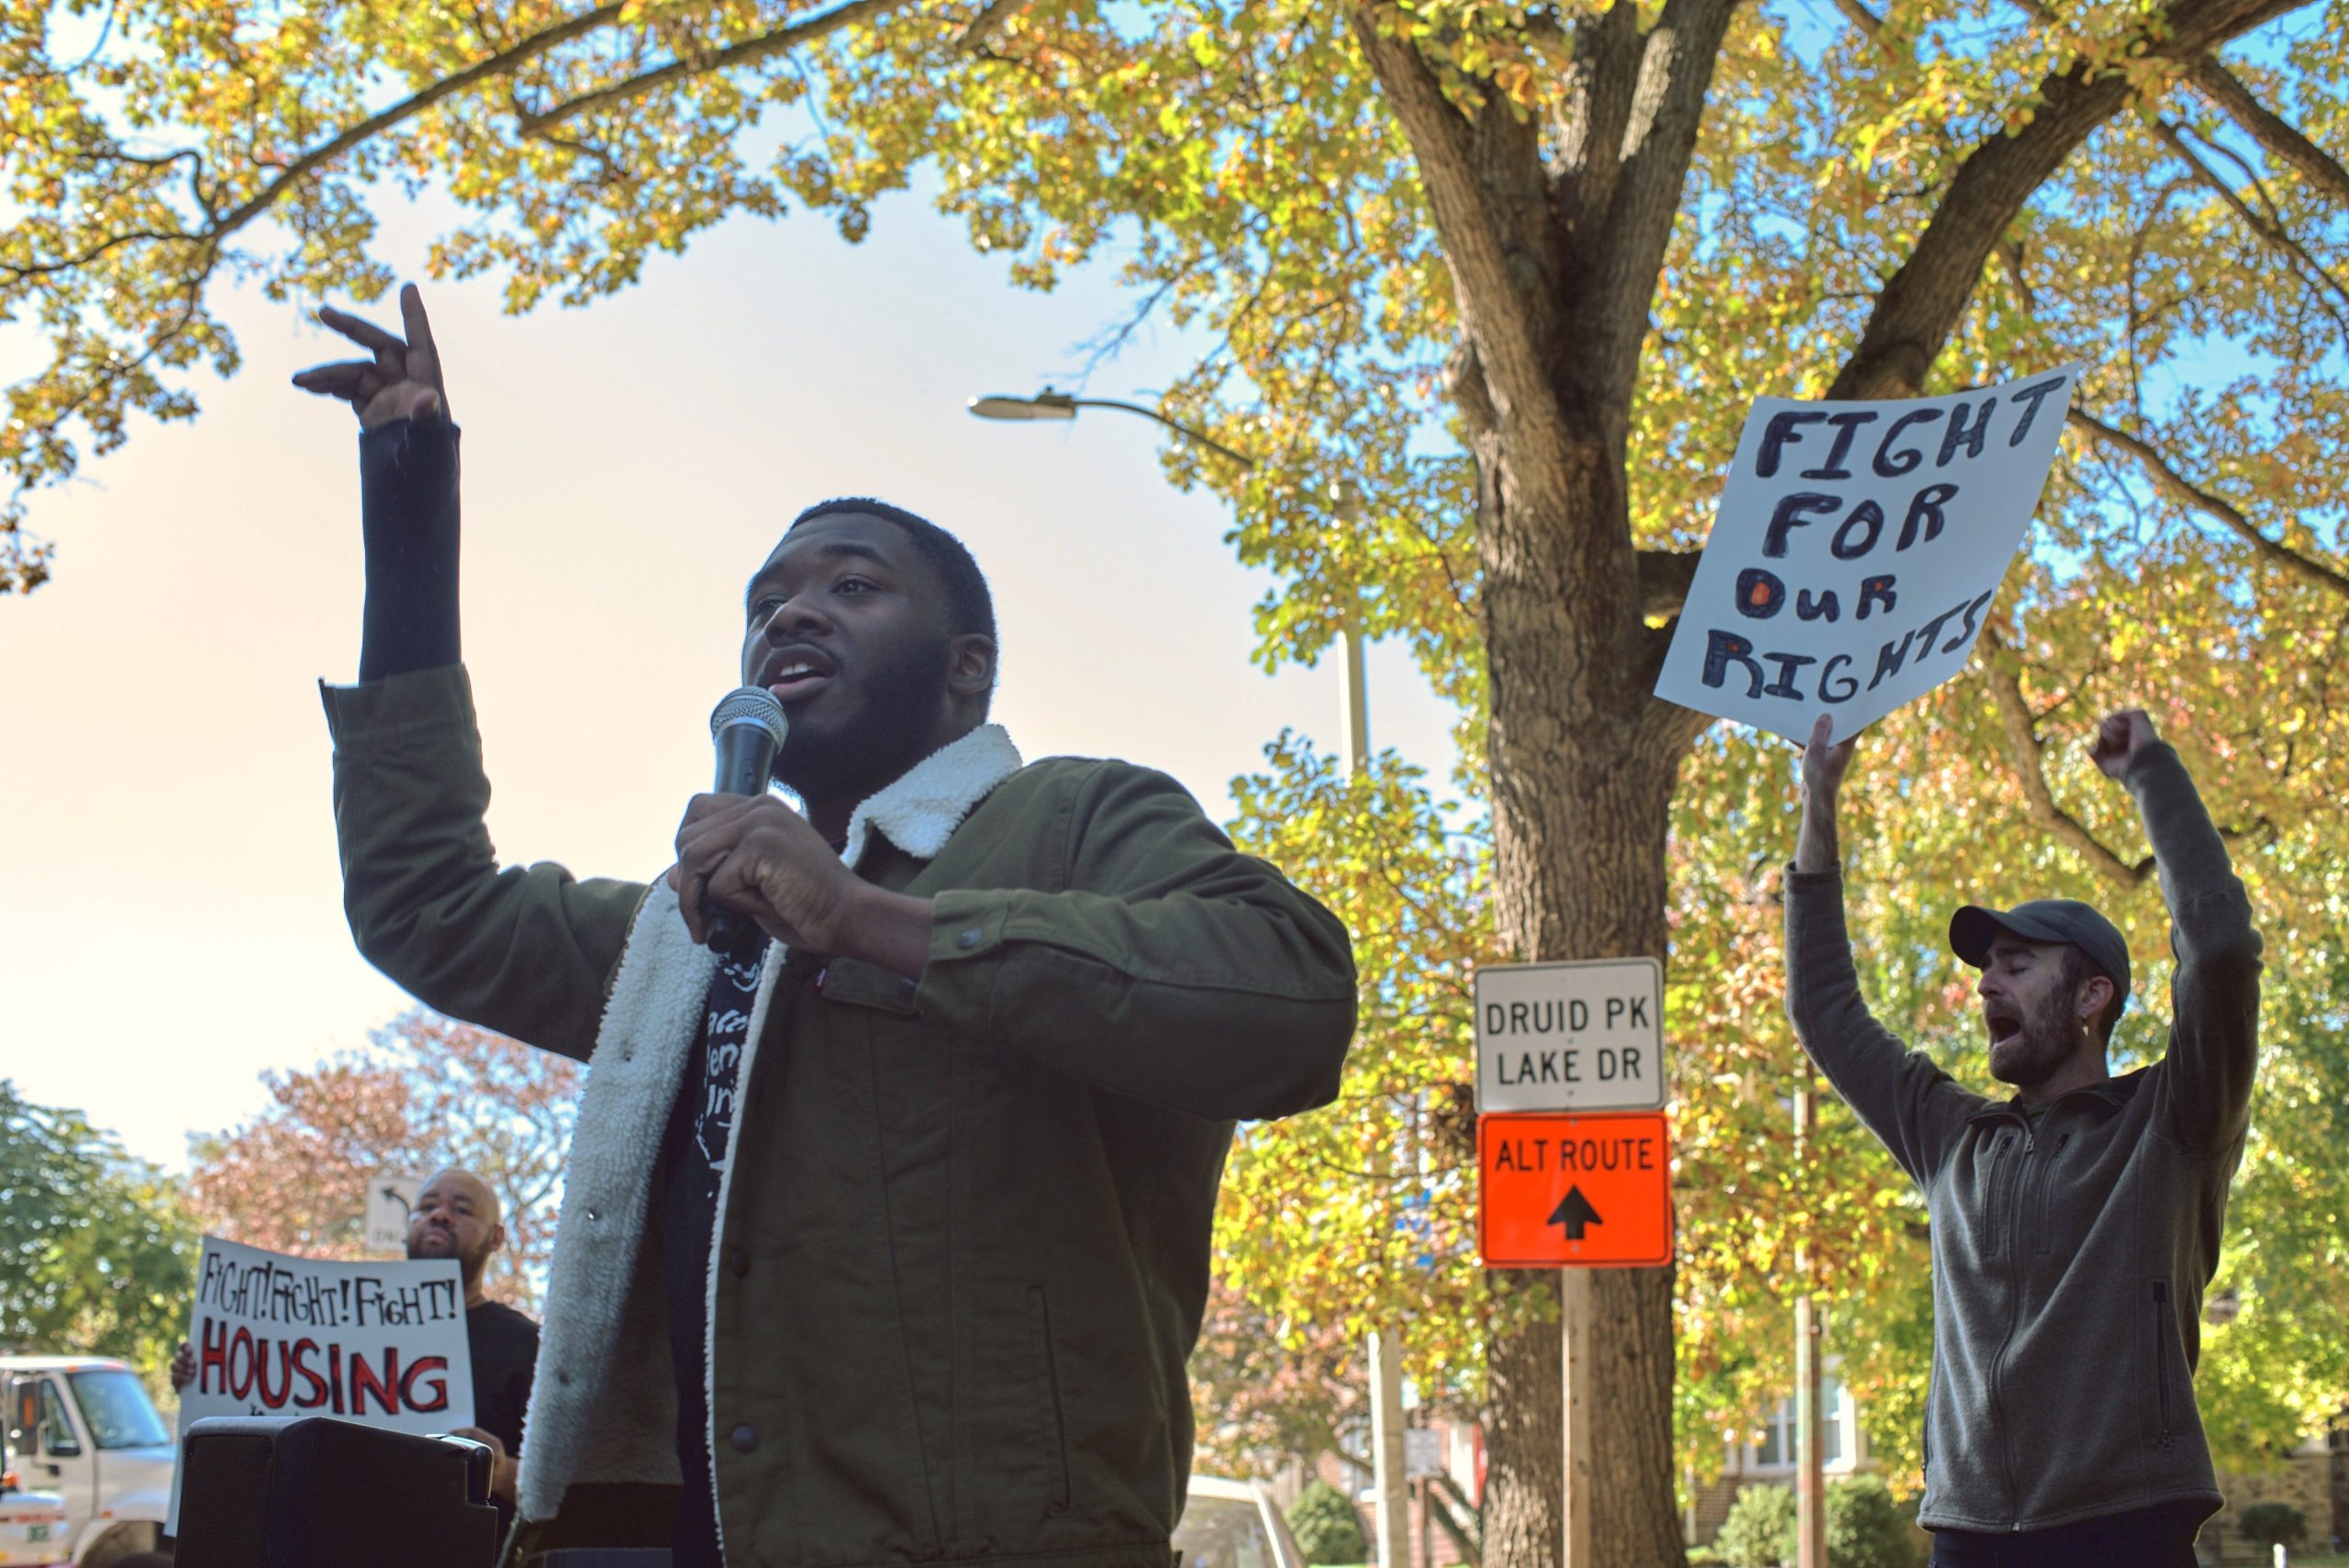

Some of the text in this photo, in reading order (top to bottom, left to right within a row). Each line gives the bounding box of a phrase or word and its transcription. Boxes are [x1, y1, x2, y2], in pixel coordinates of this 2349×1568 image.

[1756, 375, 2067, 479] FIGHT
[1762, 483, 1959, 560] FOR
[1701, 589, 1993, 704] RIGHTS
[1486, 996, 1649, 1035] DRUID PK
[1497, 1048, 1642, 1084] LAKE DR
[1495, 1139, 1654, 1173] ALT ROUTE
[200, 1316, 450, 1416] HOUSING
